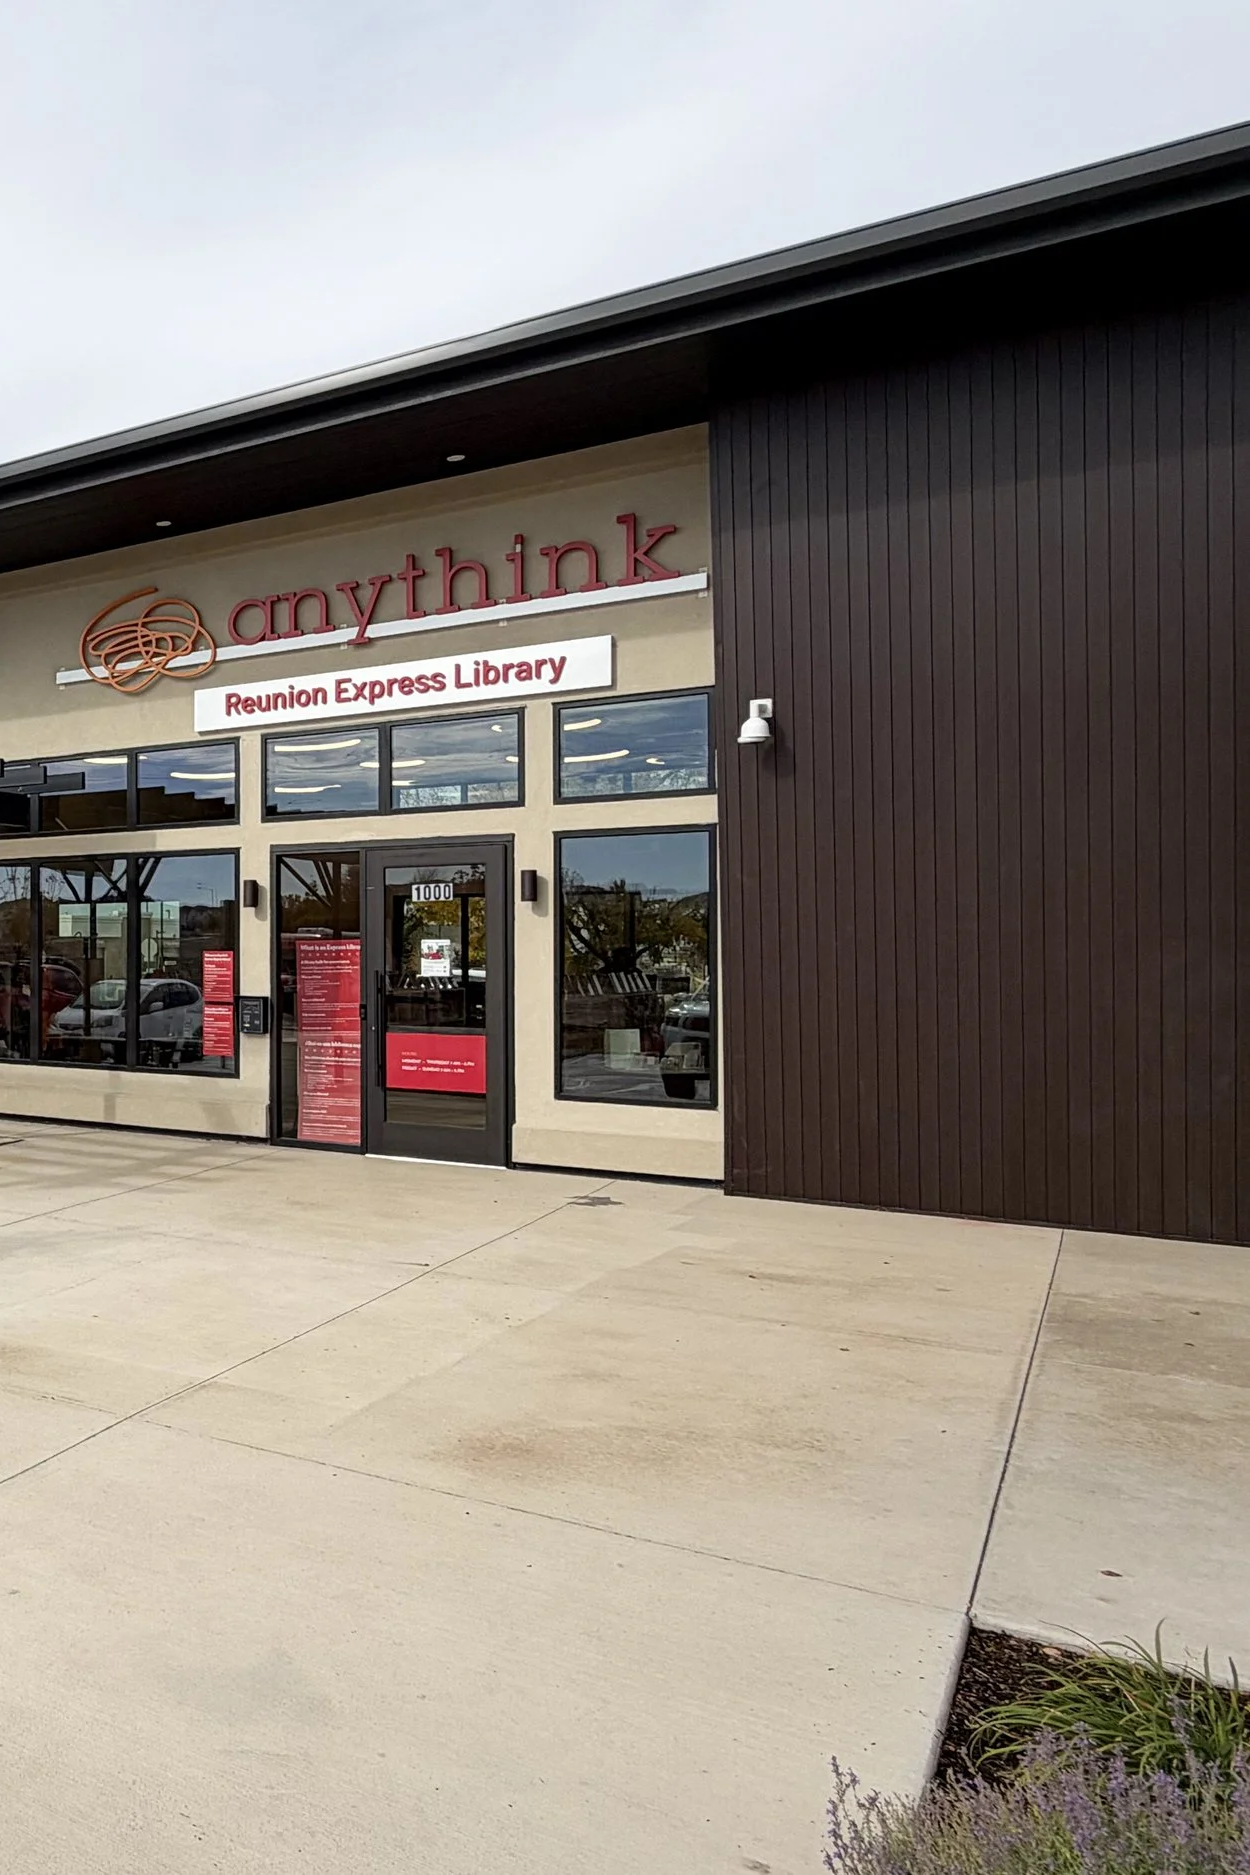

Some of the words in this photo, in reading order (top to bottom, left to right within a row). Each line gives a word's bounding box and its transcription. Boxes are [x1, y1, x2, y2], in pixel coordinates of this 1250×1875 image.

[227, 512, 681, 645] anythink
[225, 685, 328, 717] Reunion
[334, 671, 447, 705] Express
[454, 655, 567, 689] Library
[414, 884, 451, 900] 1000
